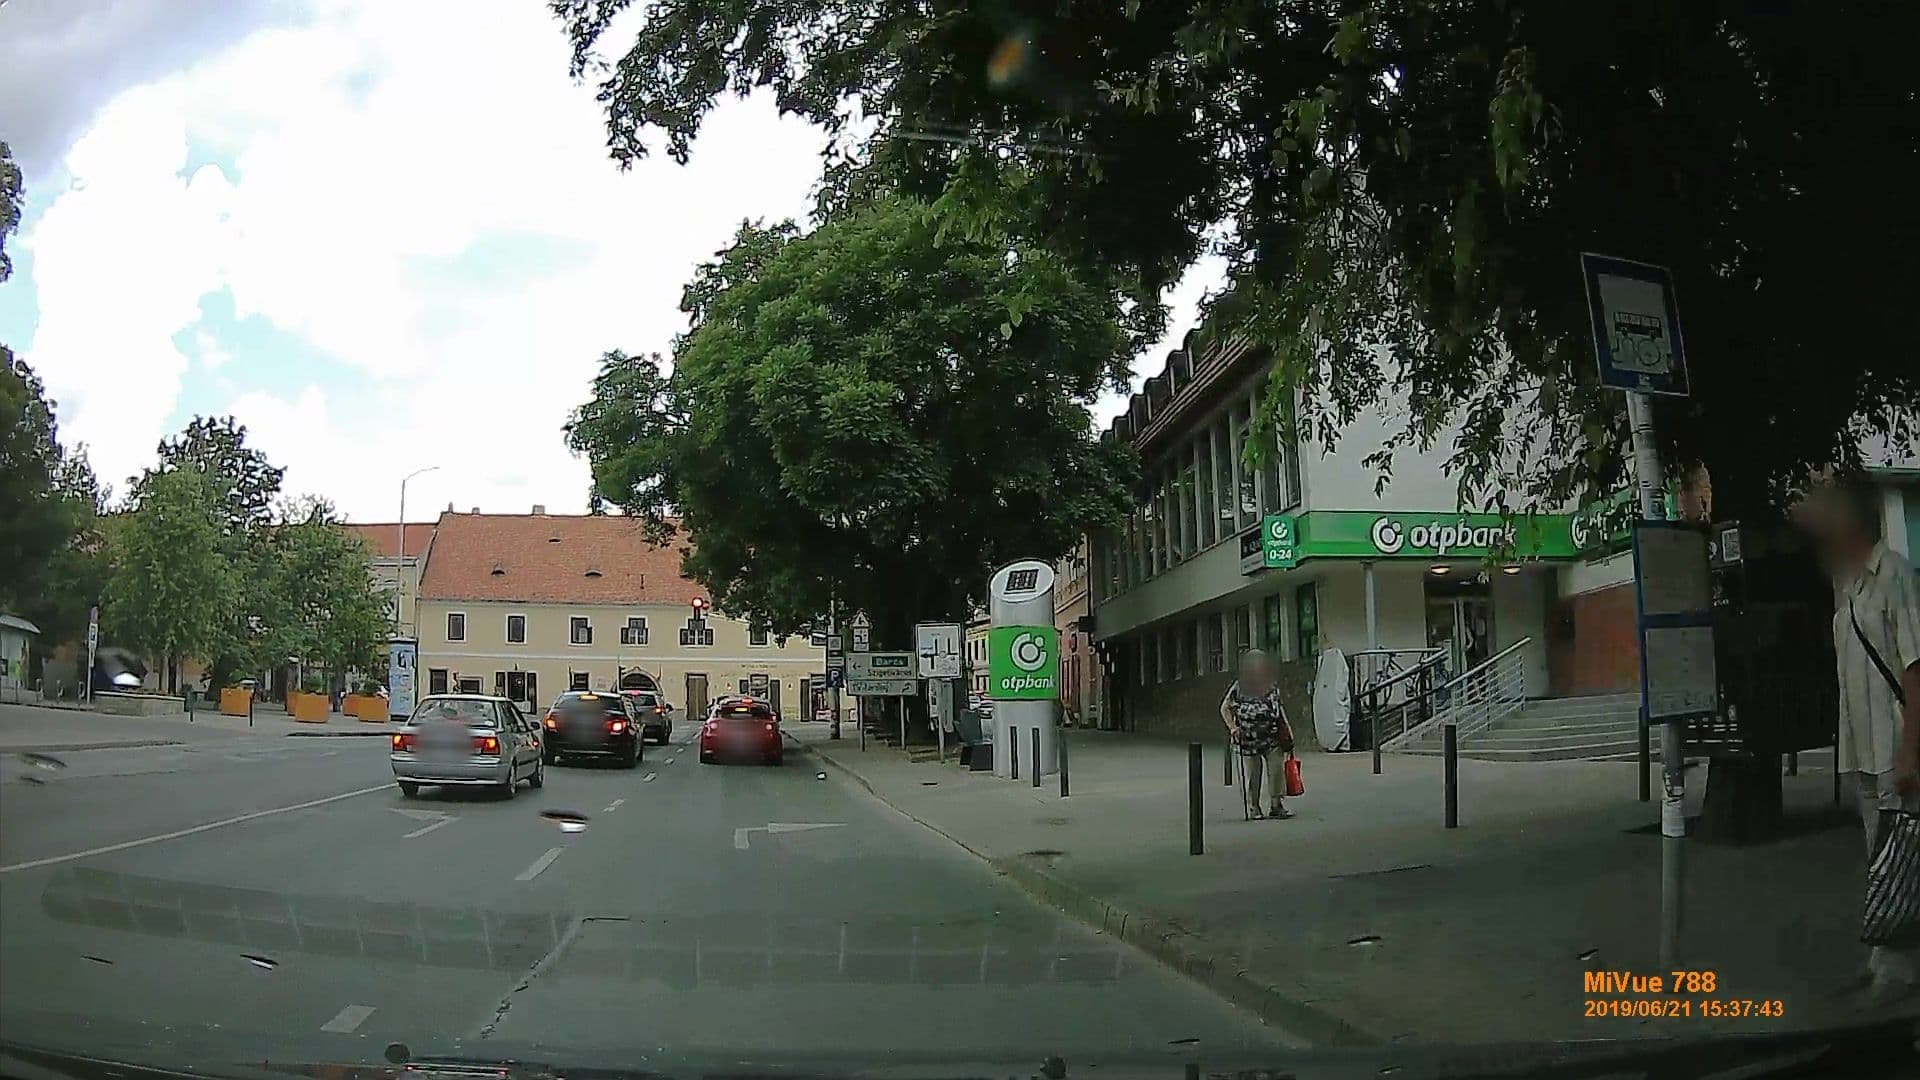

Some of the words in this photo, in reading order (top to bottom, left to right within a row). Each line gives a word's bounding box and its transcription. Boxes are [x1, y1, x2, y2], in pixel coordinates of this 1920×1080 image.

[1410, 519, 1516, 555] otpbank
[1270, 549, 1292, 560] 0-24
[1001, 674, 1055, 693] otpbank
